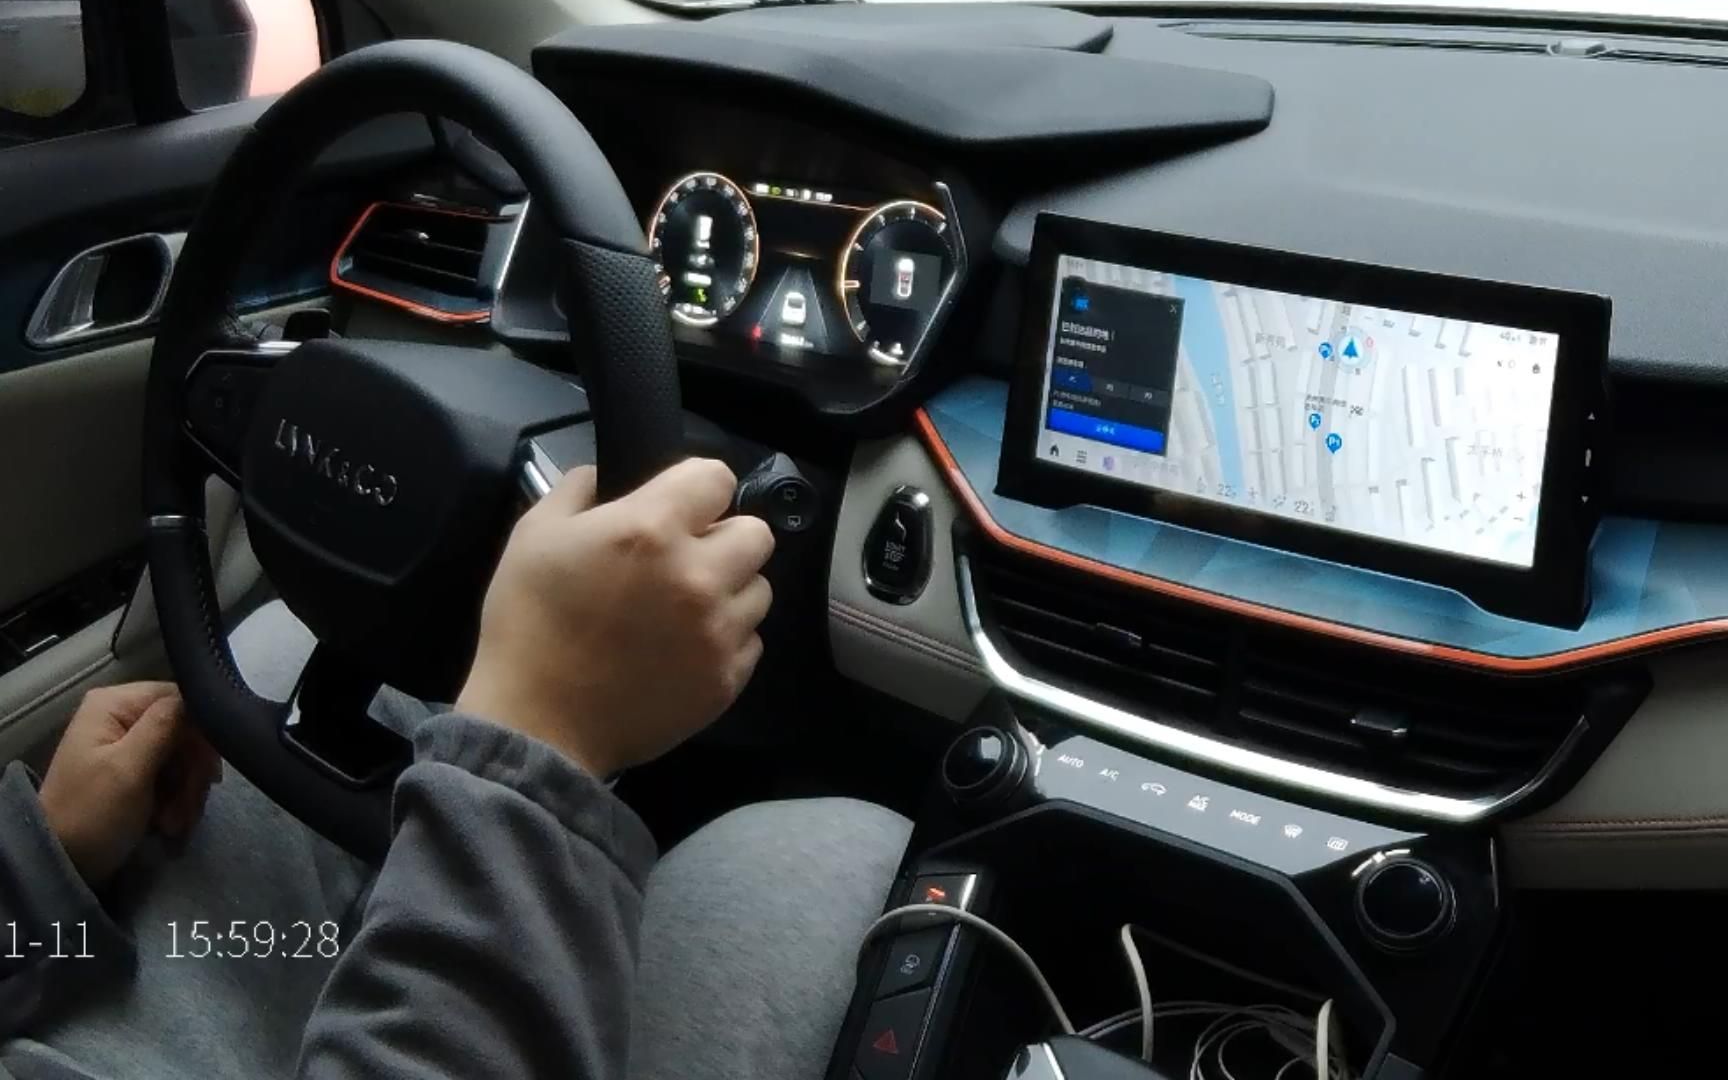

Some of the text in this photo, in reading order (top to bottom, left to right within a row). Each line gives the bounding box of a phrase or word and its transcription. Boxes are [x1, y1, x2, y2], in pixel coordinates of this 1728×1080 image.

[1057, 753, 1085, 769] AUTO
[1099, 767, 1120, 781] A/C
[1229, 809, 1263, 826] MODE
